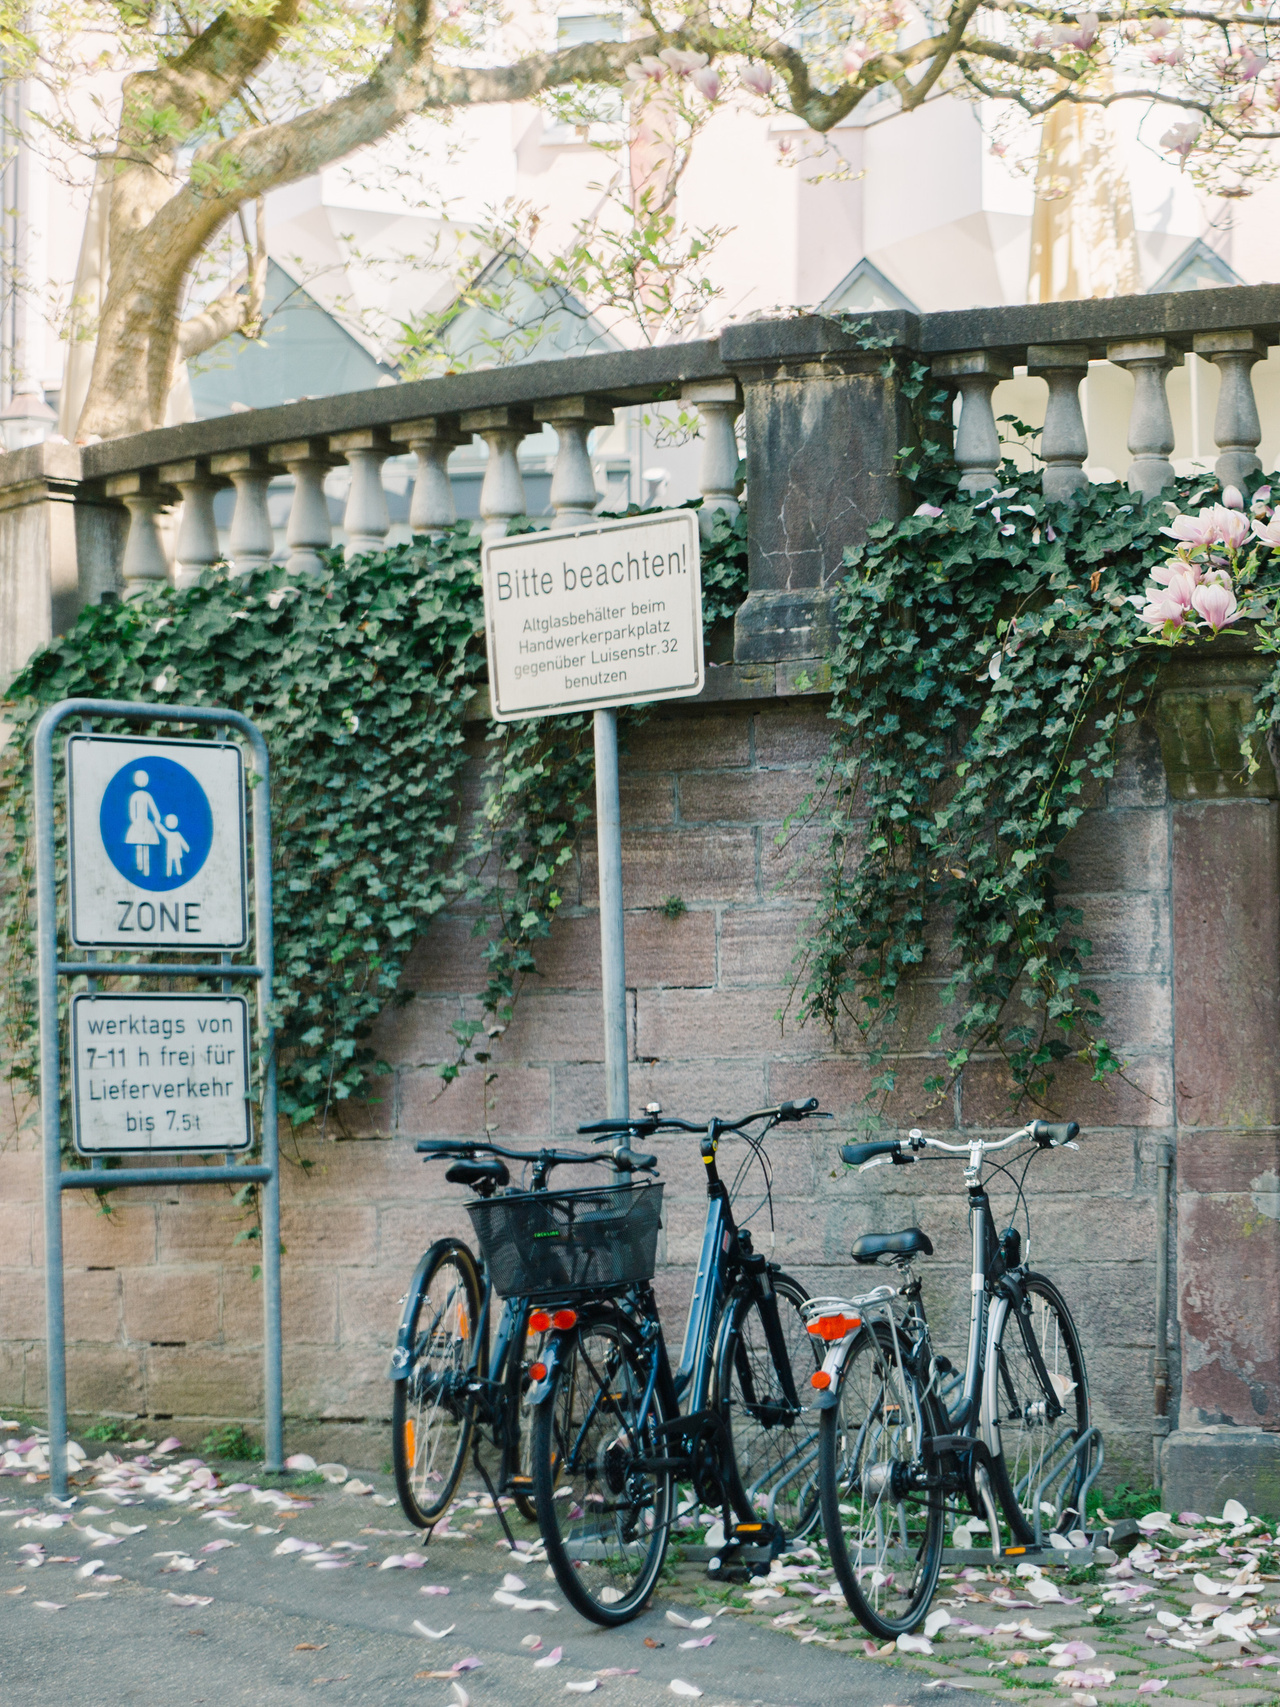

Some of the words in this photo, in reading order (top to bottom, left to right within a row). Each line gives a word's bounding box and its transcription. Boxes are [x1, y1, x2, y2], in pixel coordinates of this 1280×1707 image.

[497, 570, 553, 601] Bitte
[563, 543, 687, 591] beachten!
[522, 606, 626, 633] Altglasbehälter
[631, 599, 666, 616] beim
[518, 619, 671, 655] Handwerkerparkplatz
[514, 653, 586, 680] gegenüber
[564, 670, 627, 690] benutzen
[117, 901, 201, 932] ZONE
[88, 1014, 186, 1040] werktags
[197, 1016, 233, 1034] von
[87, 1047, 127, 1068] 7-11
[138, 1046, 150, 1067] h
[161, 1046, 195, 1066] frei
[206, 1045, 235, 1065] für
[89, 1077, 234, 1101] Lieferverkehr
[126, 1110, 155, 1132] bis
